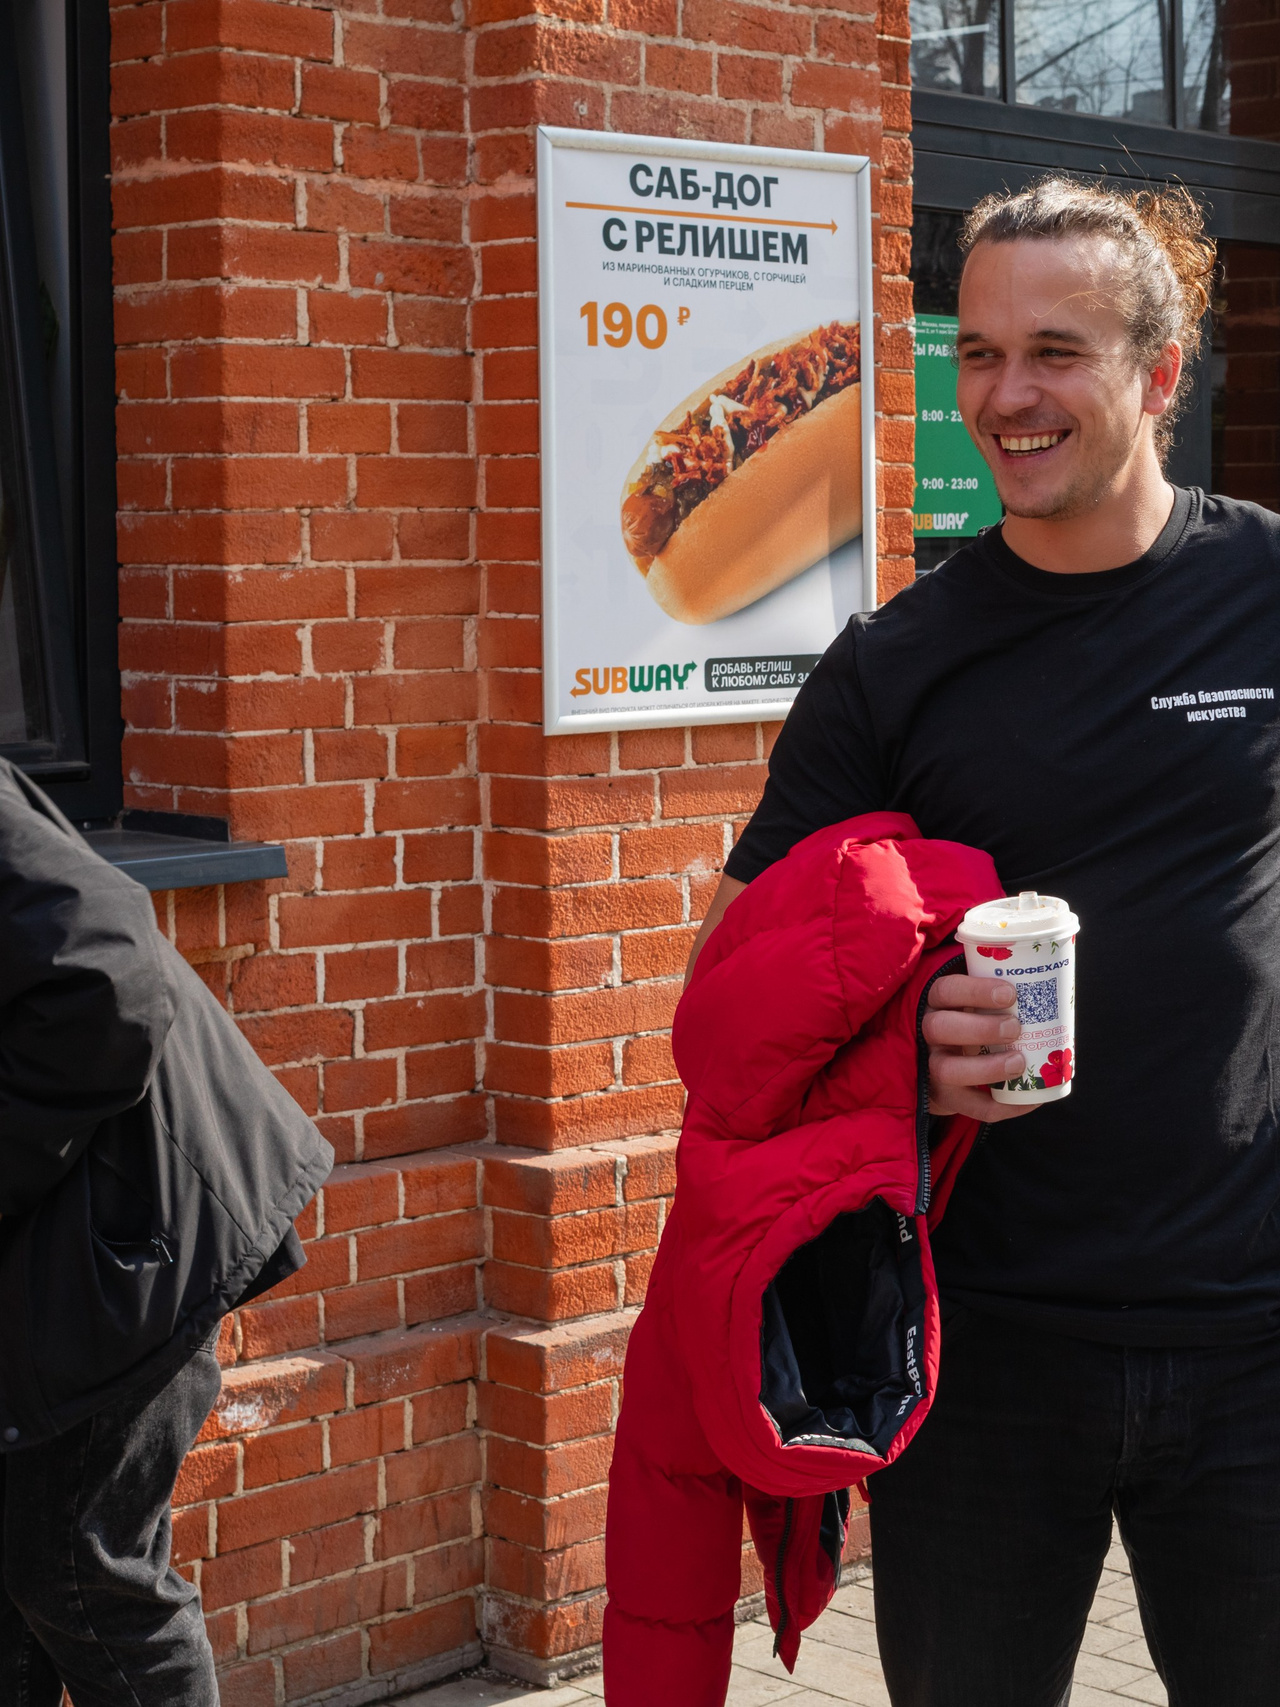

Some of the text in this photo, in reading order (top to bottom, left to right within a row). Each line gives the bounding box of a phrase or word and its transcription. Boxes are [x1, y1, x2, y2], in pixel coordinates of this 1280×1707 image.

[629, 163, 779, 210] САБ-ДОГ
[602, 217, 809, 265] С РЕЛИШЕМ
[602, 261, 807, 284] ИЗ МАРИНОВАННЫХ ОГУРЧИКОВ, С ГОРЧИЦЕЙ
[663, 277, 754, 291] И СЛАДКИМ ПЕРЦЕМ
[580, 300, 668, 350] 190
[922, 410, 944, 422] 8:00
[922, 478, 944, 490] 9:00
[951, 478, 979, 490] 23:00
[914, 512, 969, 531] UBWAY
[711, 660, 792, 677] ДОБАВЬ РЕЛИШ
[570, 660, 698, 699] SUBWAY
[711, 676, 720, 688] К
[720, 674, 768, 688] ЛЮБОМУ
[769, 673, 797, 686] САБУ
[1151, 688, 1275, 710] Служба безопасности
[1187, 706, 1247, 722] искусства
[1006, 958, 1070, 976] КОФЕХАУЗ
[1019, 1025, 1069, 1041] ЮБОВЬ
[1018, 1033, 1070, 1052] ГОРОДЕ
